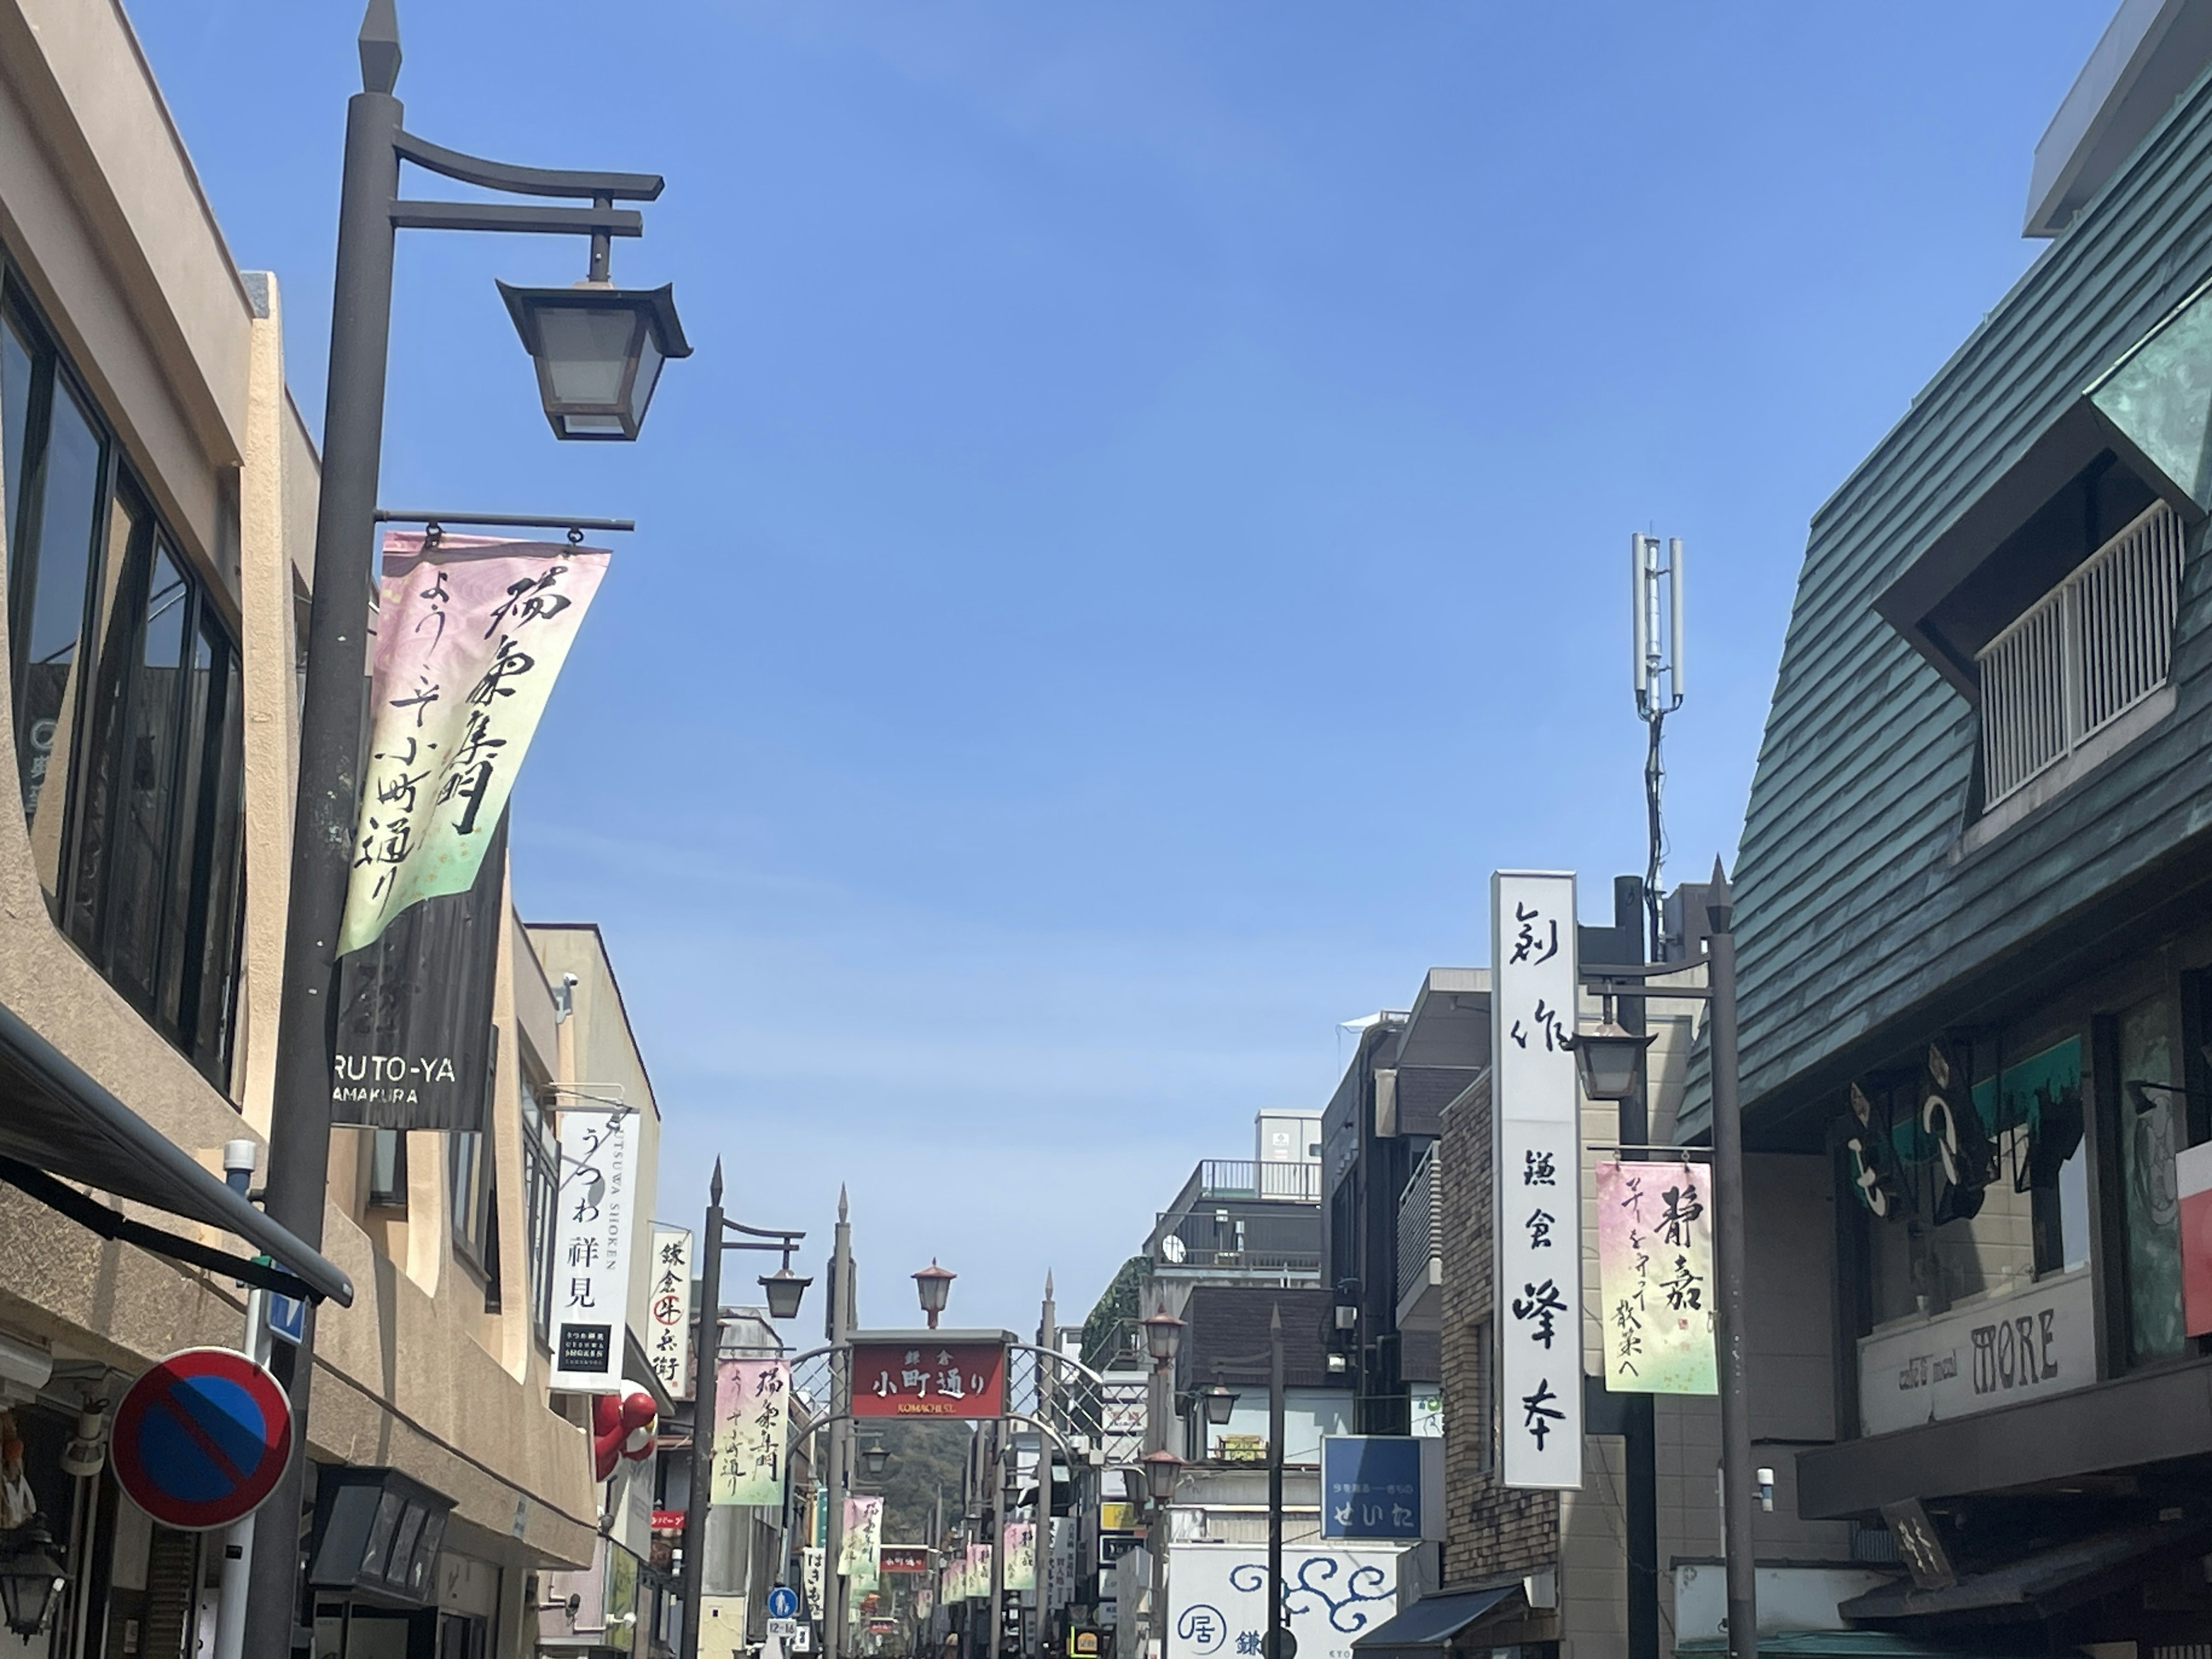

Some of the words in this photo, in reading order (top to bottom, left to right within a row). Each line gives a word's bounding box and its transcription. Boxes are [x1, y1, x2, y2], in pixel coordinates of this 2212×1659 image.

[1509, 902, 1566, 1054] 創作
[565, 1127, 600, 1308] うつわ祥見
[605, 1203, 622, 1270] SHOKEN
[872, 1367, 984, 1399] 小町通り
[1971, 1308, 2058, 1395] MORE
